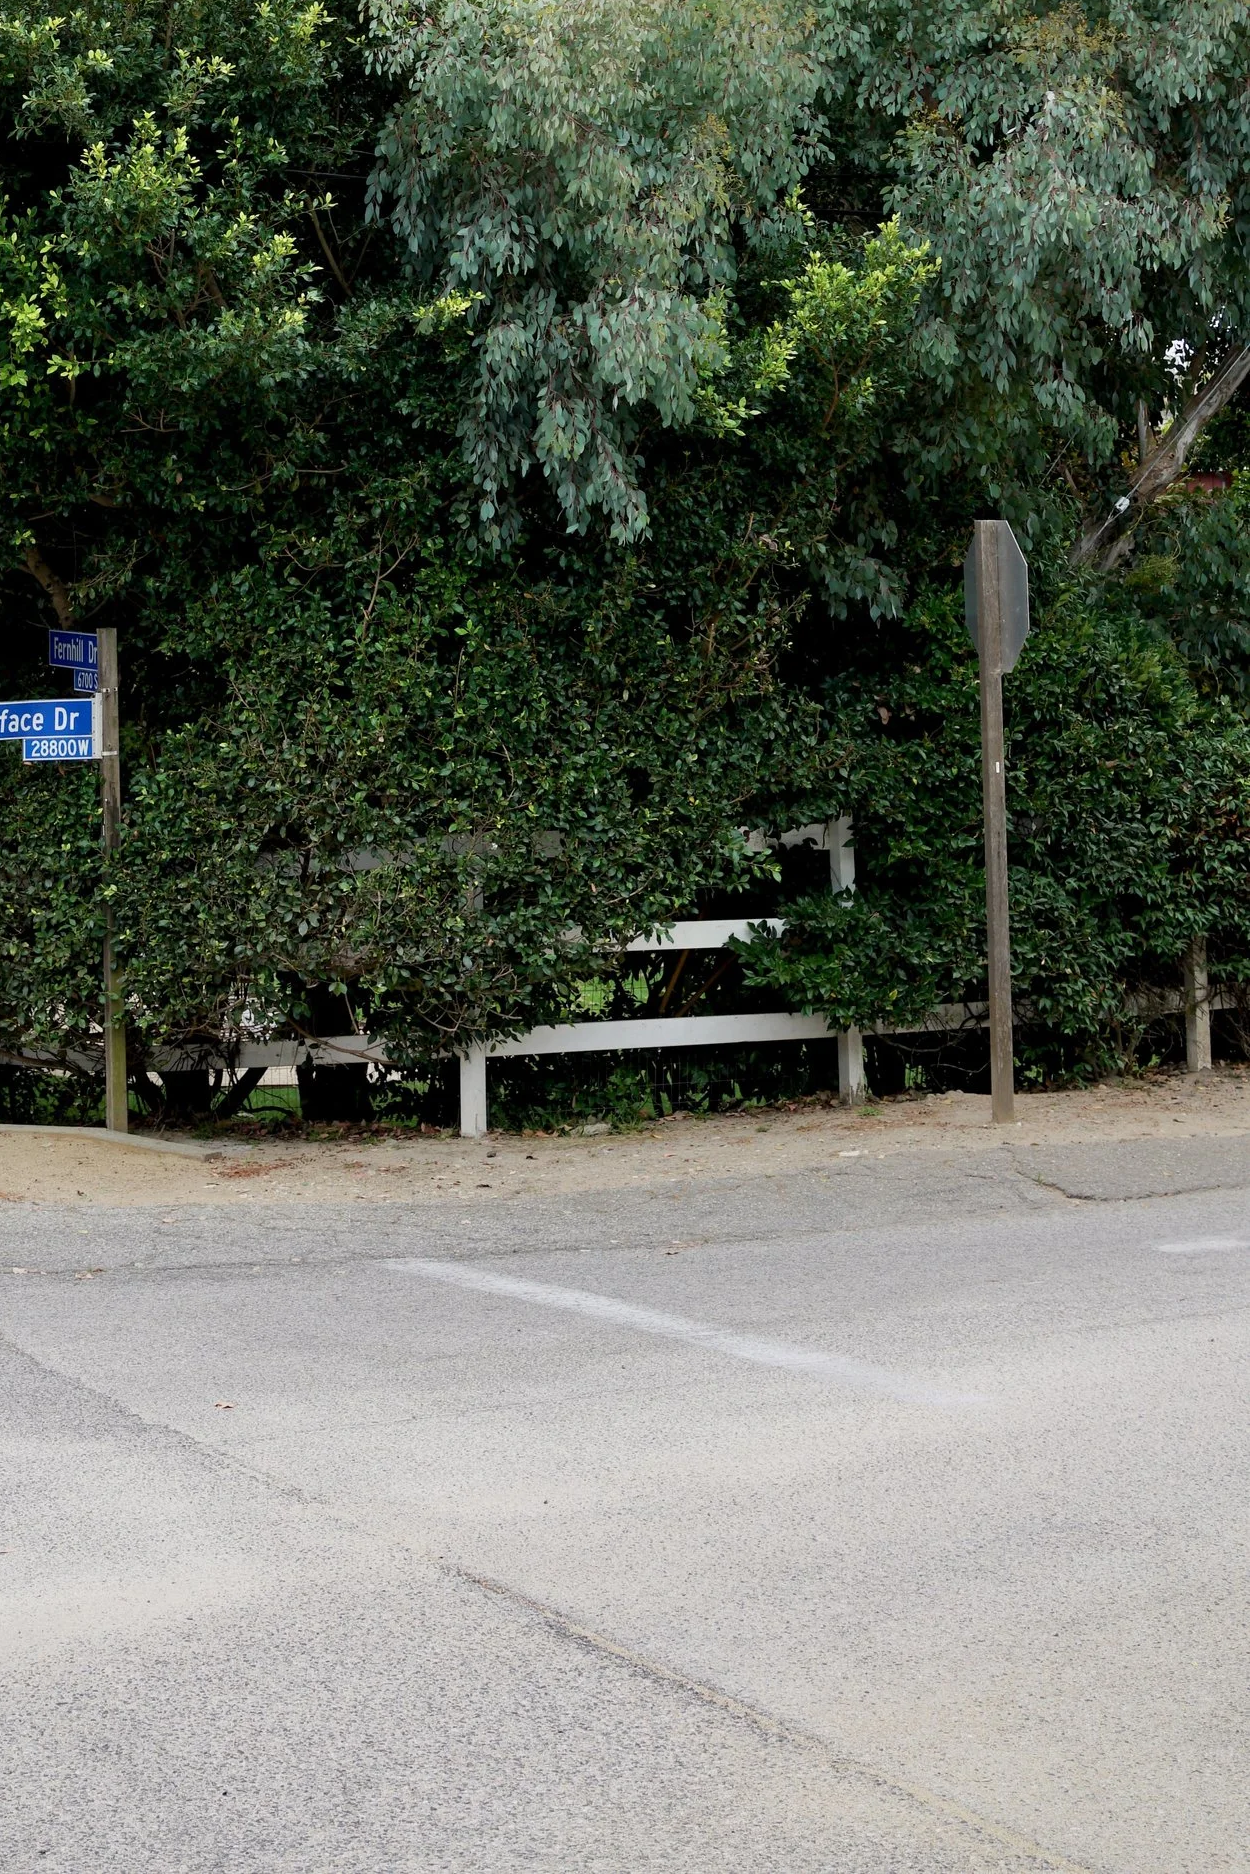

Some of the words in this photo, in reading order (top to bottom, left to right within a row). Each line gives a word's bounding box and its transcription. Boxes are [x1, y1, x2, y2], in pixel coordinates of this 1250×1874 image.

[53, 636, 84, 663] Fernhill
[88, 640, 98, 664] Dr
[77, 671, 93, 689] 6700
[54, 707, 80, 731] Dr
